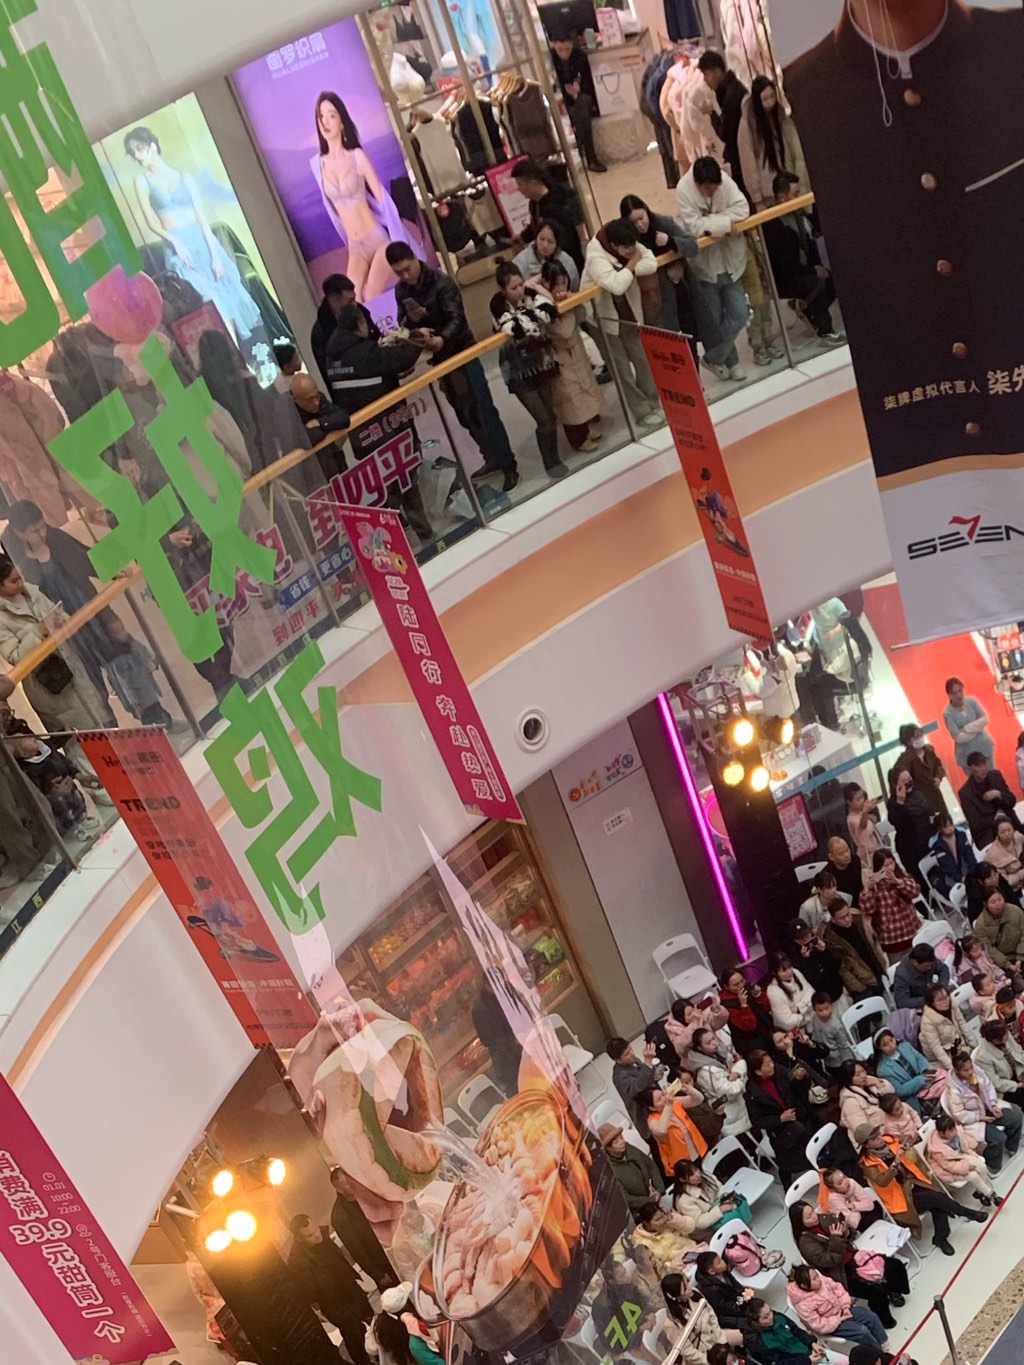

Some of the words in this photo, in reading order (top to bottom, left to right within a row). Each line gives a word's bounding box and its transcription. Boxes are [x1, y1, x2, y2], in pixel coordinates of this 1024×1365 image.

[119, 796, 182, 813] TREND
[42, 1180, 67, 1193] 01.01
[49, 1191, 74, 1204] 10:00
[57, 1203, 82, 1216] 22:00
